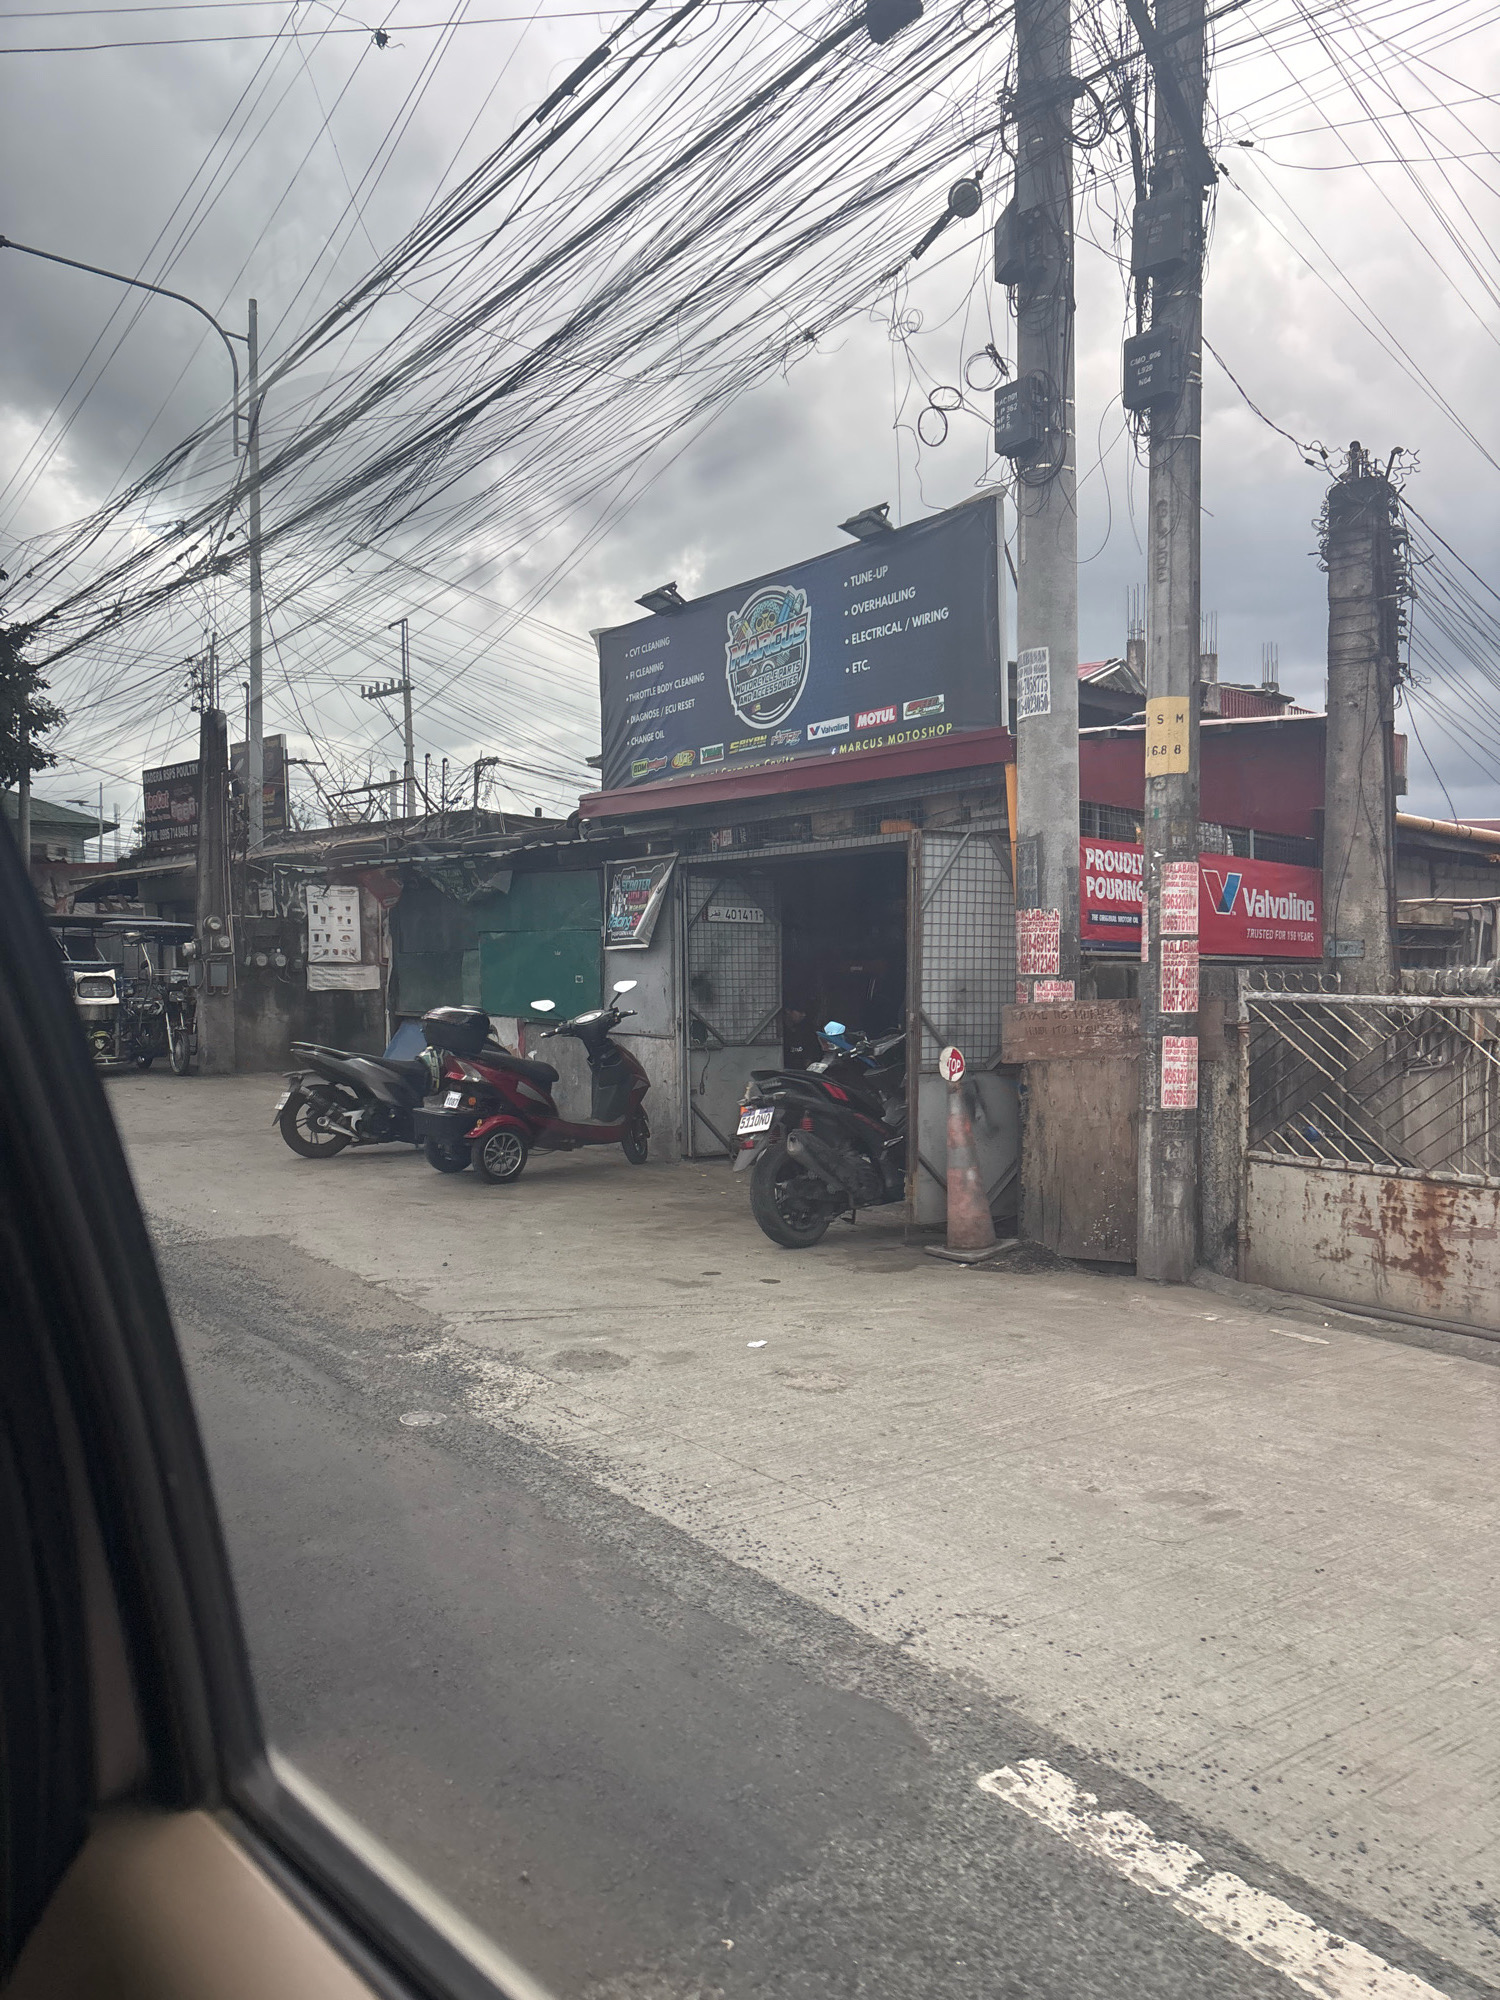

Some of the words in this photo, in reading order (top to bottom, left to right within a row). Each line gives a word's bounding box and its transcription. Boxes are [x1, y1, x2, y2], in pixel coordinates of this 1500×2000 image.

[850, 565, 888, 587] TUNE-UP
[850, 586, 916, 616] OVERHAULING
[851, 620, 903, 645] ELECTRICAL
[904, 617, 910, 632] /
[912, 606, 949, 628] WIRING
[629, 646, 641, 658] CVT
[641, 636, 671, 654] CLEANING
[730, 614, 807, 672] MARCUS
[635, 661, 665, 678] CLEANING
[852, 659, 871, 674] ETC.
[629, 686, 657, 703] THROTTLE
[656, 682, 673, 694] BODY
[674, 672, 705, 689] CLEANING
[735, 669, 780, 697] MOTORCYCLE
[778, 660, 801, 677] PARTS
[739, 691, 754, 706] AND
[752, 673, 799, 700] ACCESSORIES
[630, 708, 660, 724] DIAGNOSE
[660, 706, 665, 717] /
[665, 705, 677, 715] ECU
[677, 698, 696, 711] RESET
[856, 707, 895, 728] MOTUL
[1157, 714, 1164, 725] S
[1176, 713, 1184, 724] M
[630, 732, 655, 746] CHANGE
[654, 730, 665, 740] OIL
[820, 722, 849, 735] Valvoline
[839, 737, 883, 754] MARCUS
[887, 722, 953, 745] MOTOSHOP
[1085, 847, 1144, 876] PROUDLY
[622, 879, 651, 891] SCOOTER
[1085, 875, 1144, 903] POURING
[725, 909, 759, 920] 401411
[1242, 887, 1316, 922] Valvoline
[1091, 913, 1099, 921] THE
[1098, 914, 1118, 923] ORIGINAL
[1117, 915, 1132, 924] MOTOR
[1246, 928, 1274, 940] TRUSTED
[1274, 929, 1286, 941] FOR
[1297, 931, 1314, 942] YEARS
